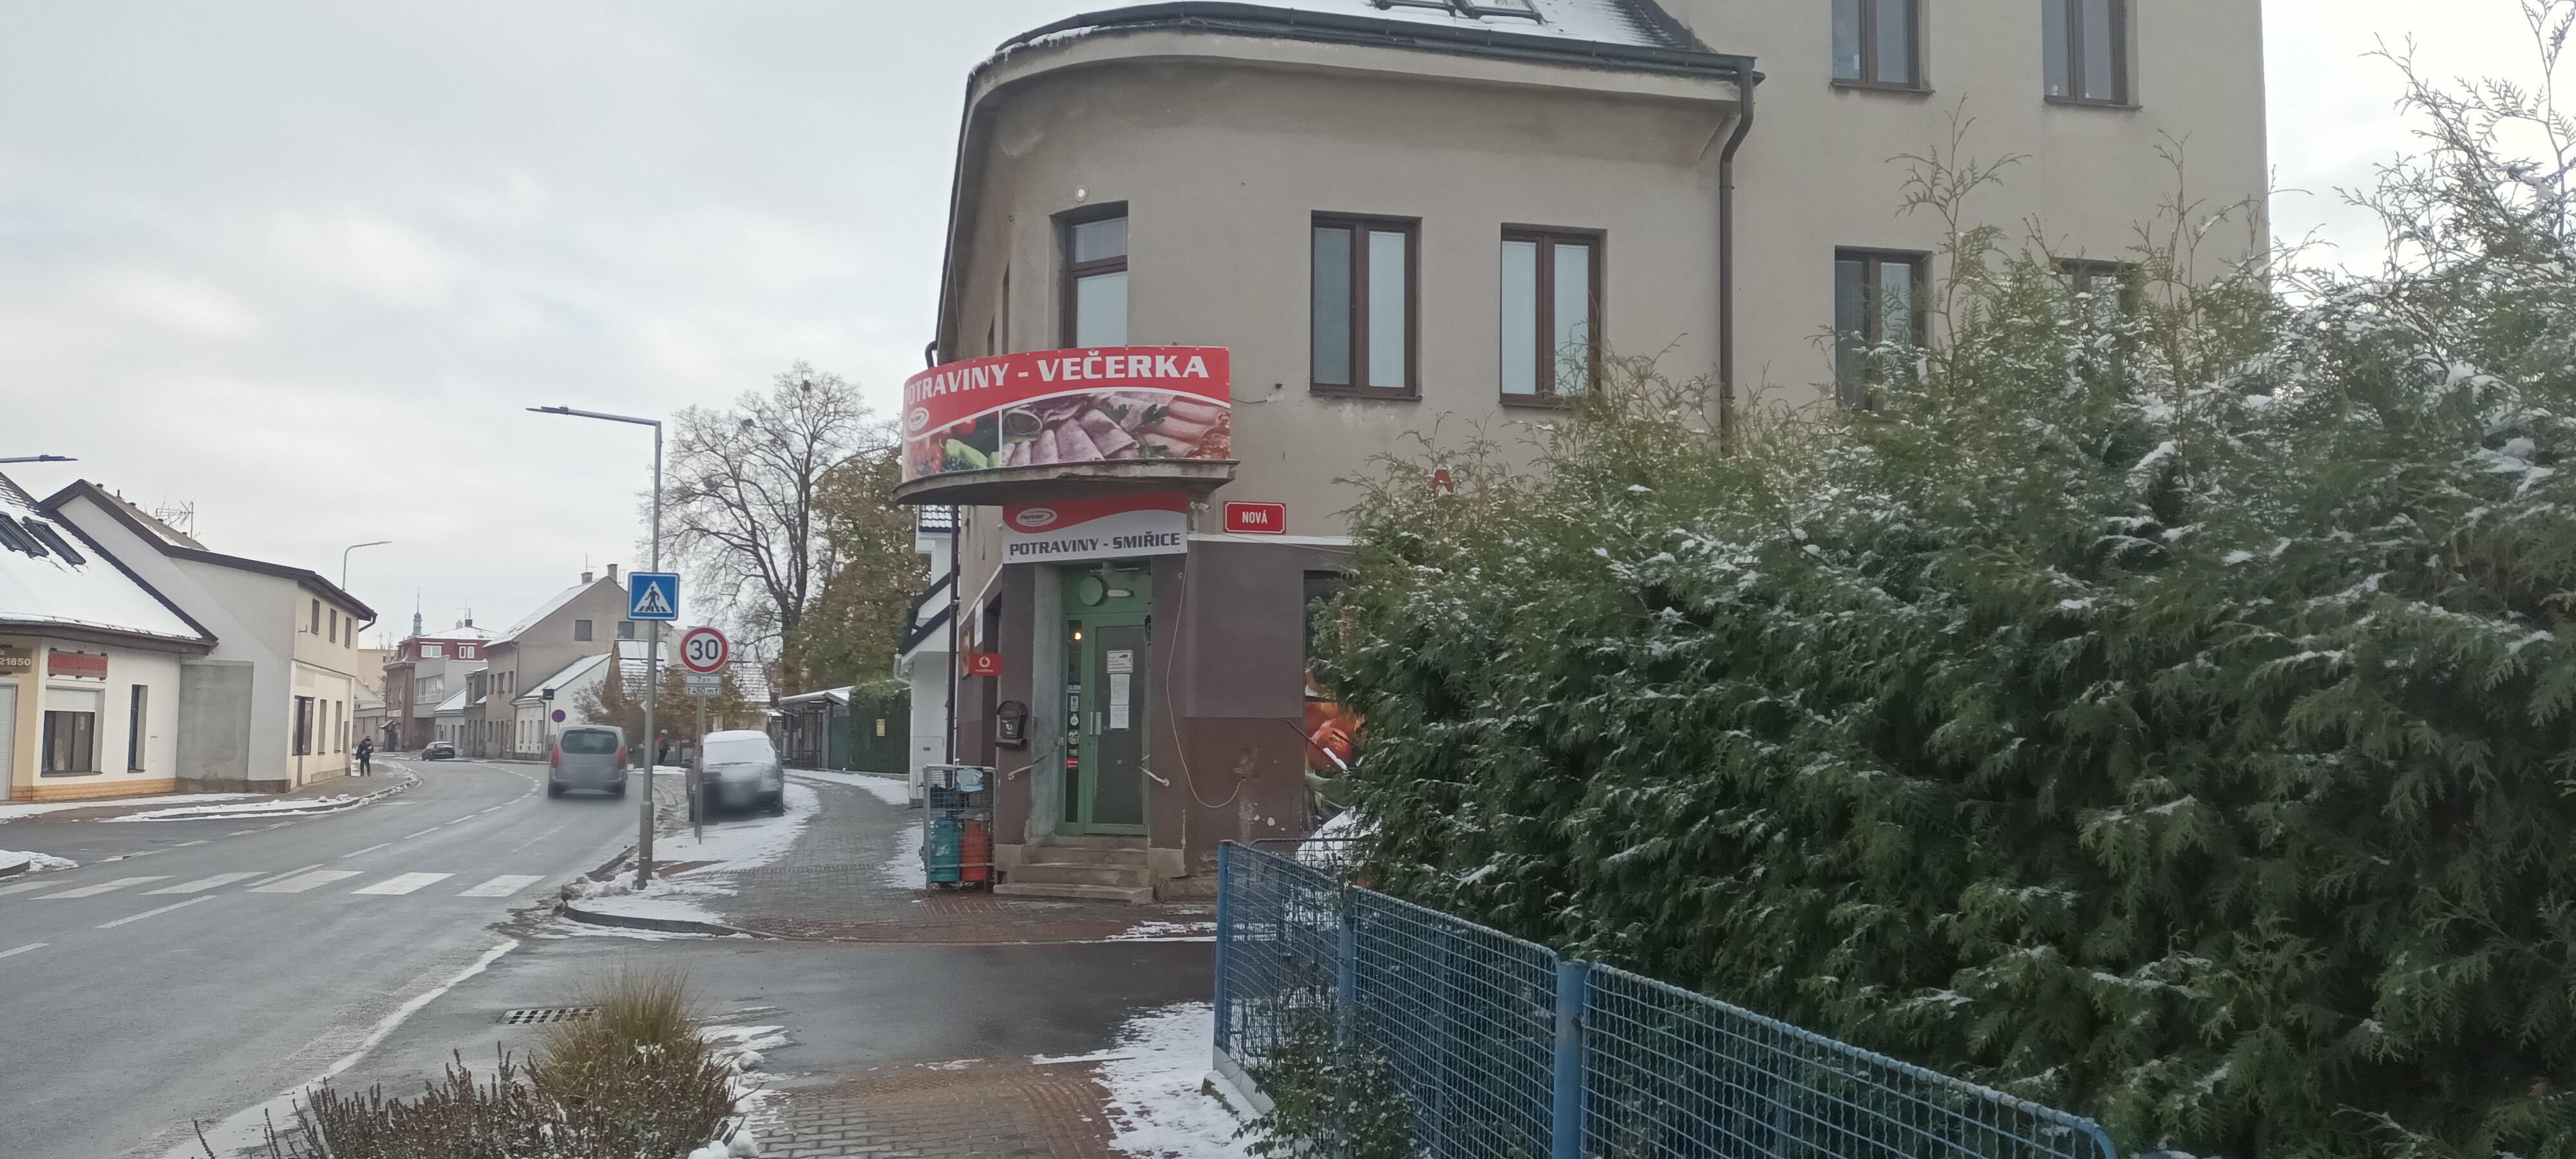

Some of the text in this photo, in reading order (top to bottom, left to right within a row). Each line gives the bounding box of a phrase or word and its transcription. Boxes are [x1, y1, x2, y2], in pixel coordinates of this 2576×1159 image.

[1037, 351, 1209, 382] VEČERKA
[1242, 509, 1267, 524] NOVÁ
[1010, 538, 1099, 556] POTRAVINY
[1113, 531, 1180, 549] SMIŘICE
[690, 639, 718, 660] 30
